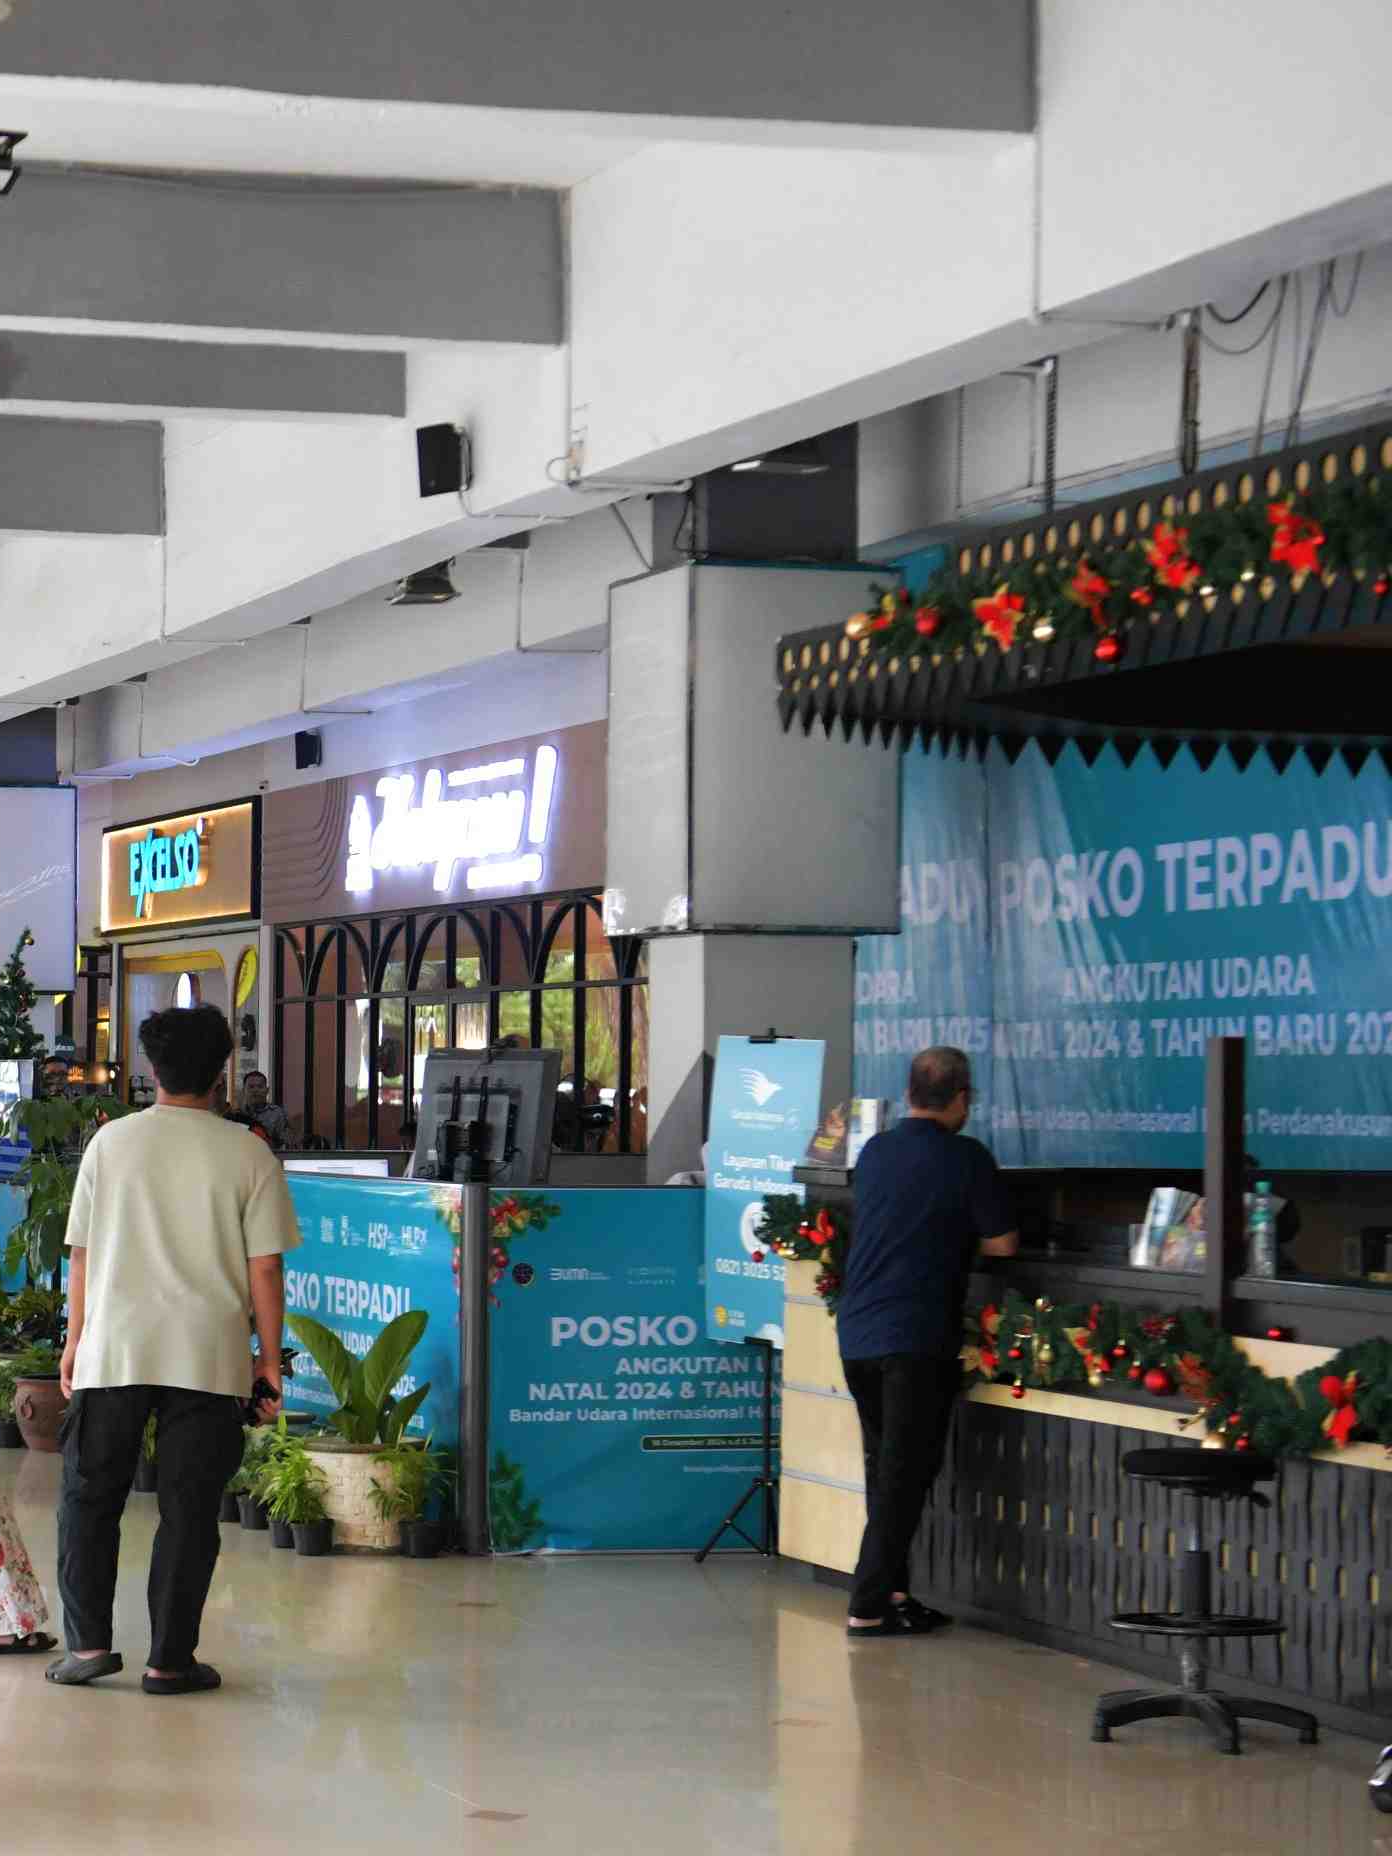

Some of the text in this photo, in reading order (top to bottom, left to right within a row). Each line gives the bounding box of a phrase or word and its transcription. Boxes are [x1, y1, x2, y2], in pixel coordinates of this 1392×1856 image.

[128, 827, 201, 919] EXCELSO
[1211, 952, 1318, 999] UDARA
[1254, 1011, 1337, 1056] BARU
[324, 1275, 410, 1323] TERPADU
[550, 1315, 697, 1347] POSKO
[615, 1357, 750, 1377] ANGKUTAN
[528, 1382, 608, 1402] NATAL
[615, 1381, 673, 1401] 2024
[679, 1381, 696, 1400] &
[509, 1407, 571, 1423] Bandar
[576, 1407, 628, 1422] Udara
[632, 1405, 745, 1421] Internasional
